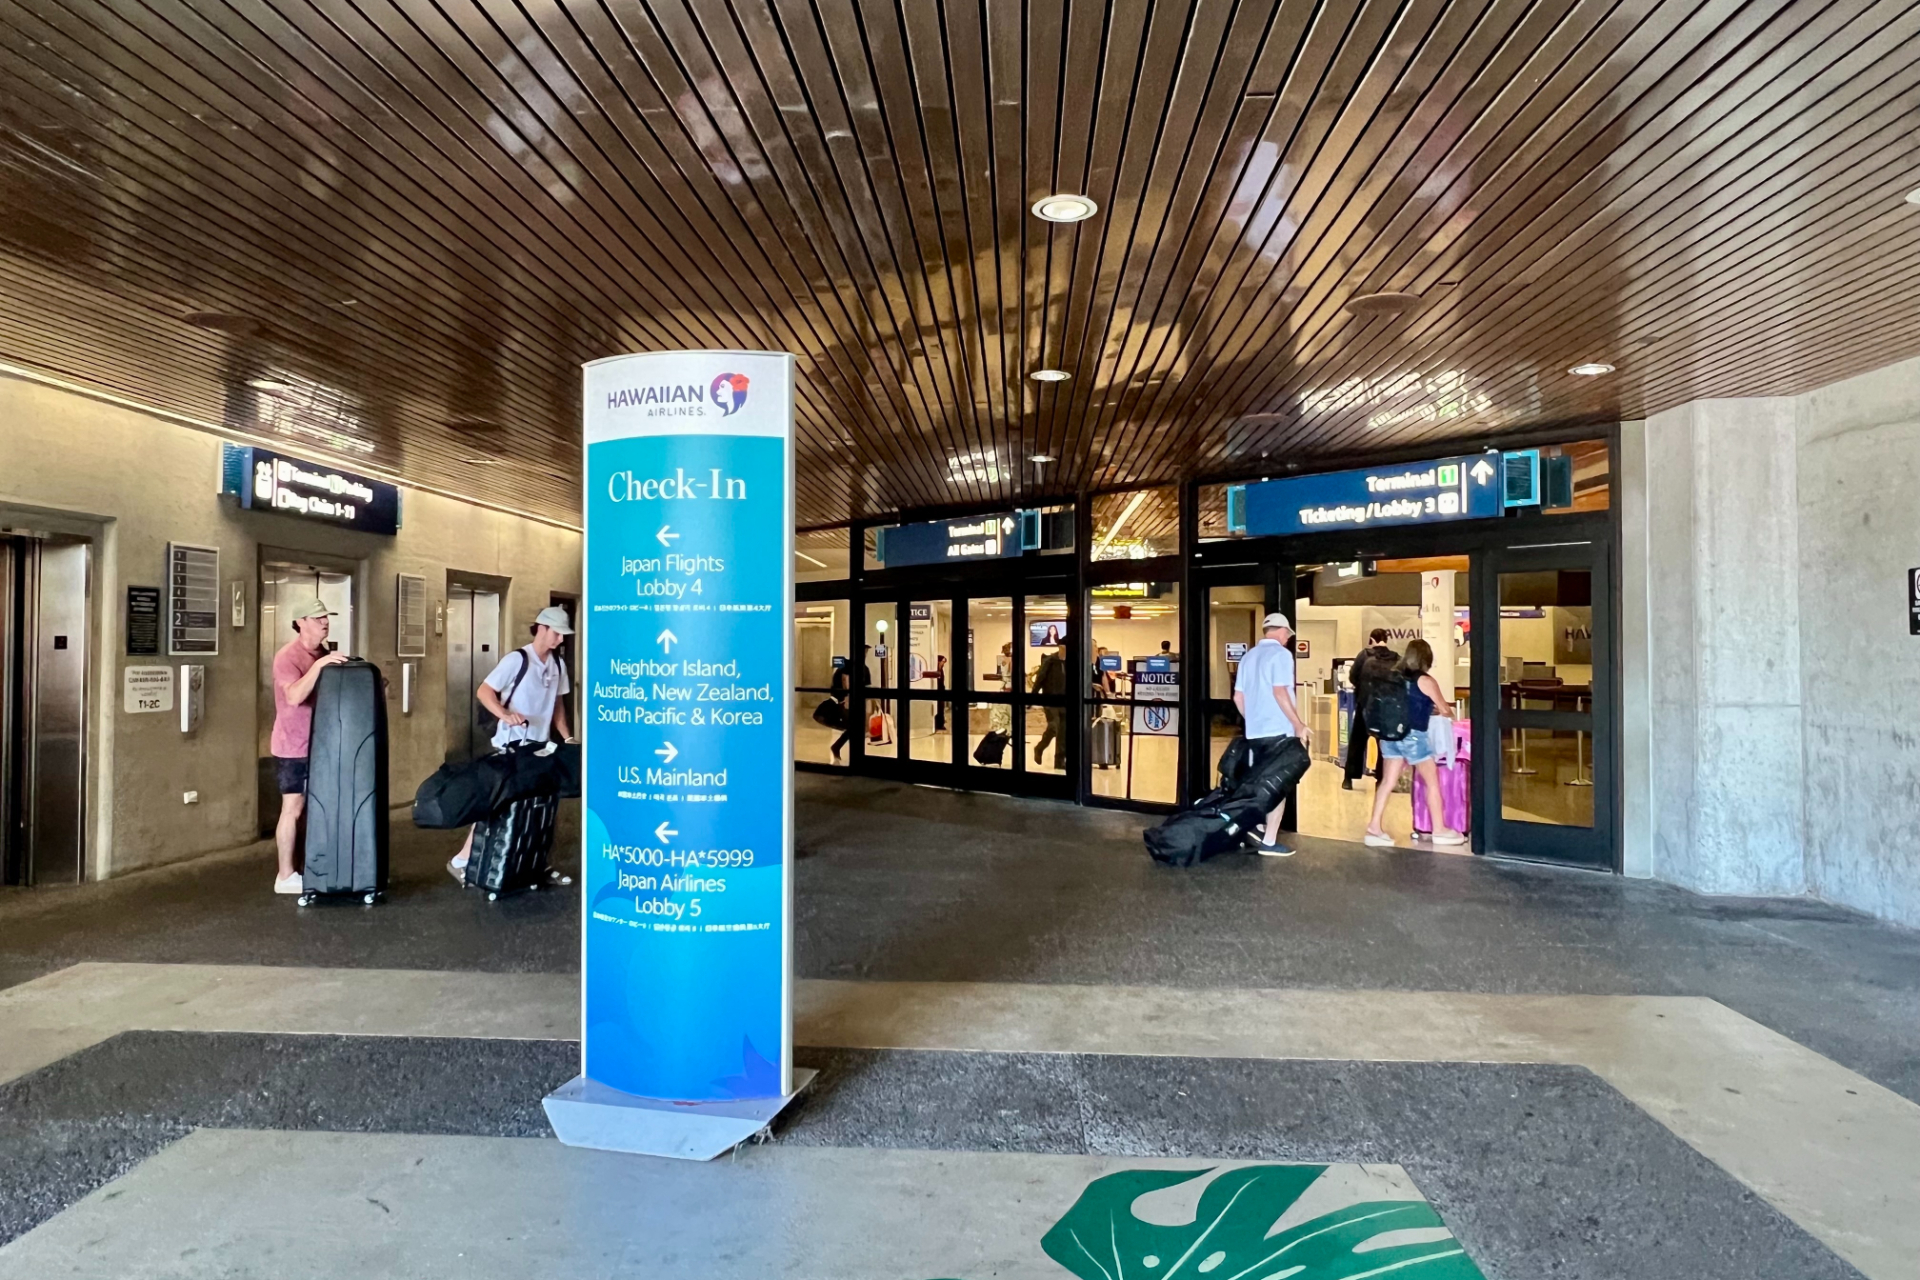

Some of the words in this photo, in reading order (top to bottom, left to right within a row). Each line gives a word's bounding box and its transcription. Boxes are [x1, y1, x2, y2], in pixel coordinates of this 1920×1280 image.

[607, 385, 704, 410] HAWAIIAN
[608, 467, 747, 503] Check-In
[1366, 469, 1435, 492] Terminal
[1424, 497, 1435, 513] 3
[620, 555, 661, 577] Japan
[665, 553, 725, 576] Flights
[636, 578, 687, 600] Lobby
[690, 578, 703, 596] 4
[174, 612, 182, 626] 2
[910, 608, 928, 617] TICE
[610, 658, 679, 680] Neighbor
[683, 659, 741, 679] Island,
[1141, 673, 1176, 684] NOTICE
[593, 681, 648, 703] Australia,
[652, 683, 693, 701] New
[696, 683, 774, 703] Zealand,
[138, 699, 160, 709] T1-2C
[597, 704, 632, 724] South
[635, 706, 686, 725] Pacific
[690, 707, 706, 726] &
[710, 708, 763, 726] Korea
[617, 765, 642, 785] U.S.
[646, 767, 727, 787] Mainland
[617, 868, 657, 892] Japan
[660, 873, 726, 893] Airlines
[635, 895, 686, 921] Lobby
[689, 898, 702, 917] 5
